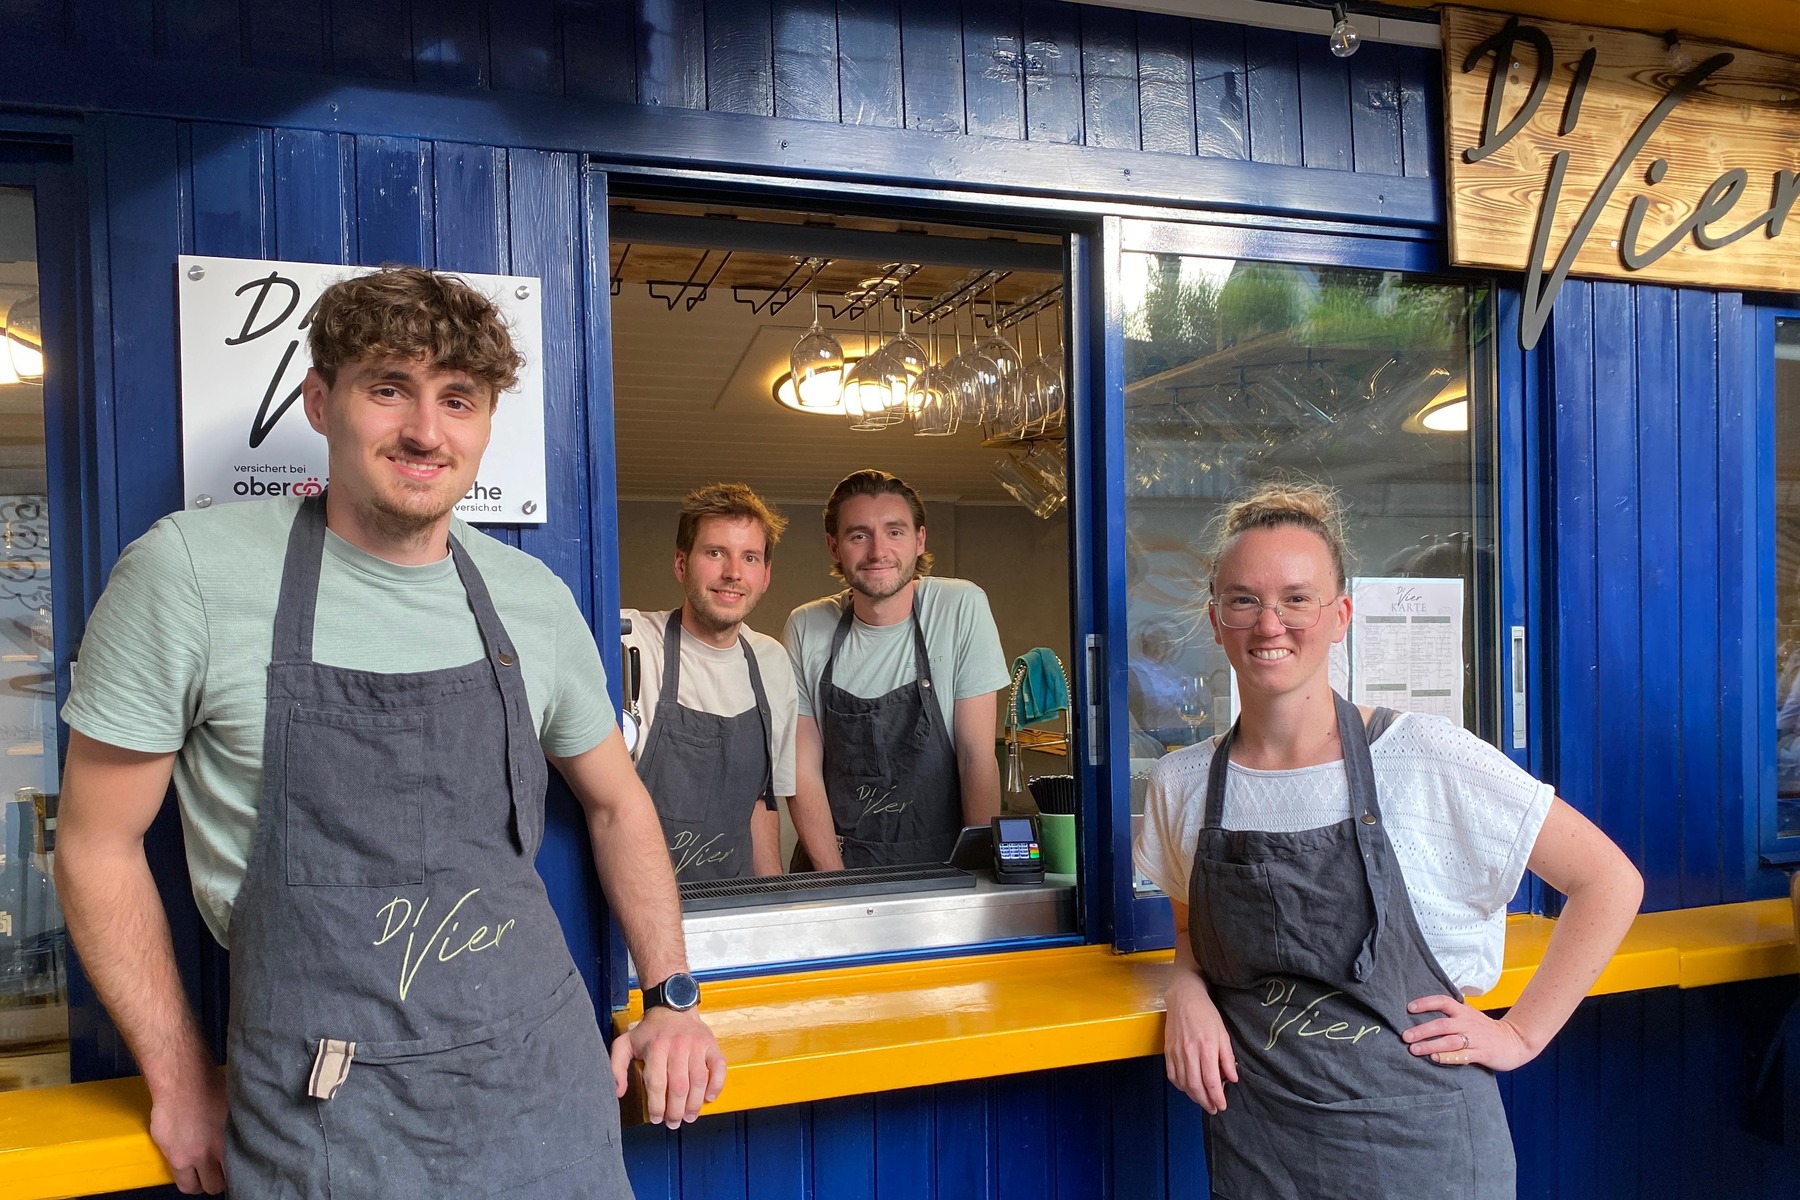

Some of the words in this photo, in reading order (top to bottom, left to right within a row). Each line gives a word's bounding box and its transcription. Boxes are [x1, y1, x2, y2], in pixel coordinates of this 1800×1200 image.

[1518, 52, 1800, 351] Vier
[233, 463, 287, 474] versichert
[289, 464, 306, 474] bei
[1391, 602, 1427, 612] KARTE
[1397, 587, 1423, 606] Vier
[674, 832, 734, 876] Vier
[400, 887, 515, 1001] Vier
[1264, 991, 1381, 1050] Vier
